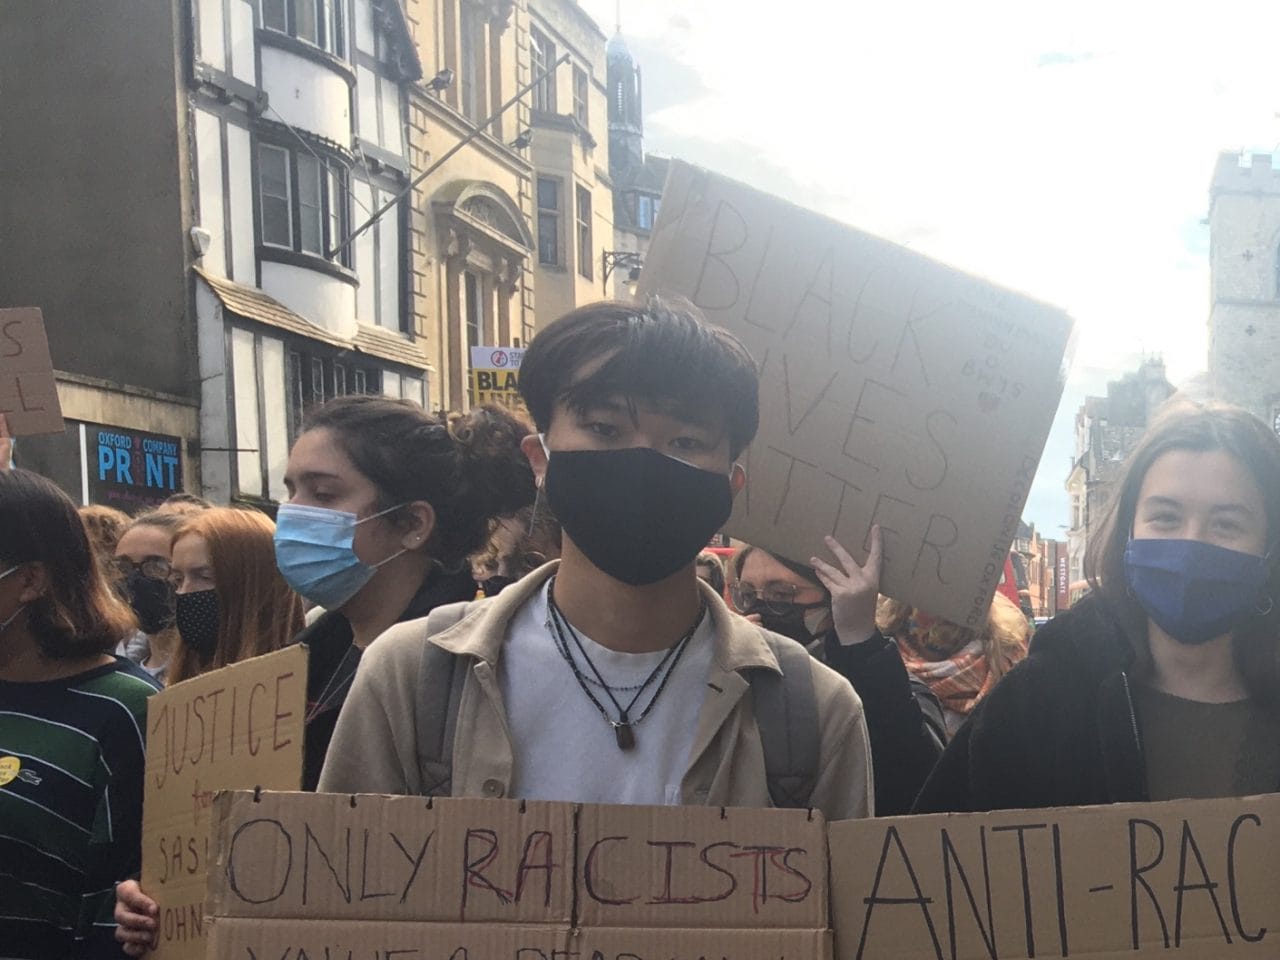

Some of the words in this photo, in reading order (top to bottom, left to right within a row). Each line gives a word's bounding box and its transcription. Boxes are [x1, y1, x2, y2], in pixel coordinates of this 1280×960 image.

[692, 199, 954, 388] BLACK
[477, 371, 518, 391] BLA
[98, 432, 132, 449] OXFORD
[143, 439, 177, 456] COMPANY
[1059, 556, 1067, 594] WESTGATE
[151, 671, 296, 790] JUSTICE
[227, 818, 434, 906] ONLY
[461, 829, 814, 921] RACISTS
